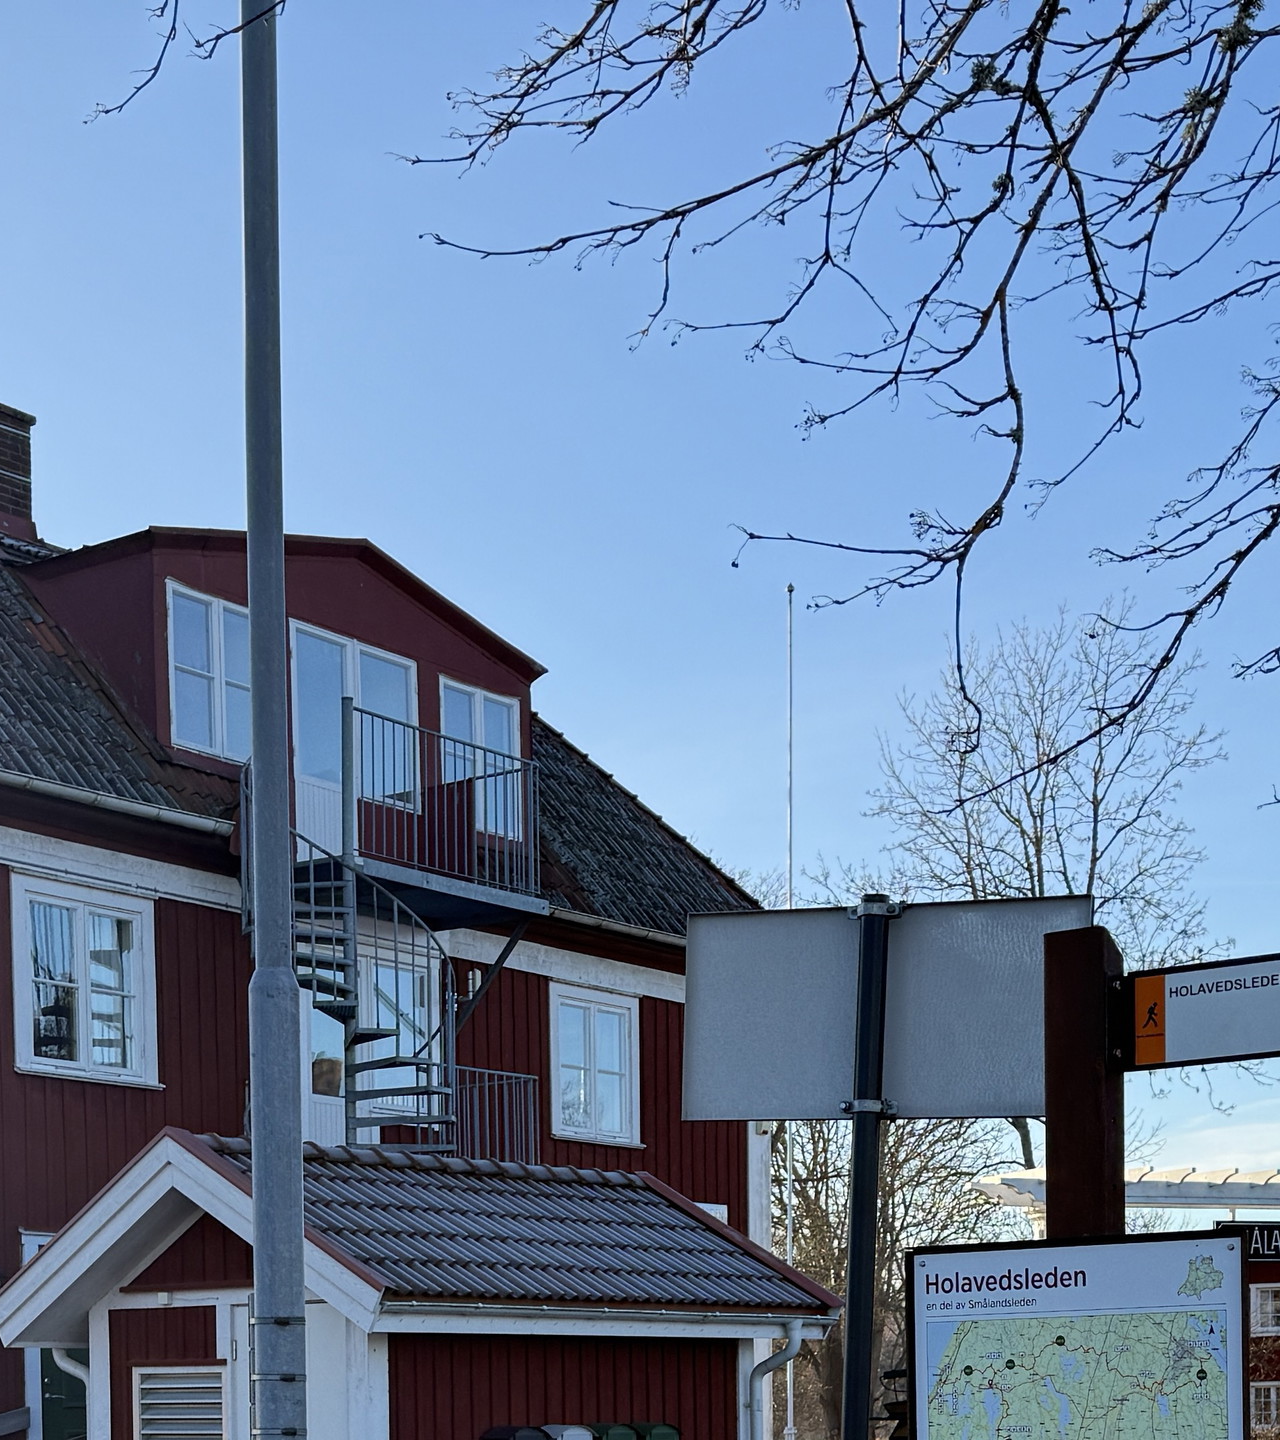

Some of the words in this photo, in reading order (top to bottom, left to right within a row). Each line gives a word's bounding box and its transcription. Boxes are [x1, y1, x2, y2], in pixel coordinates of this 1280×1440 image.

[925, 1266, 1087, 1295] Holavedsleden
[926, 1303, 937, 1311] en
[939, 1300, 953, 1310] del
[955, 1301, 966, 1310] av
[968, 1297, 1037, 1309] Smålandsleden
